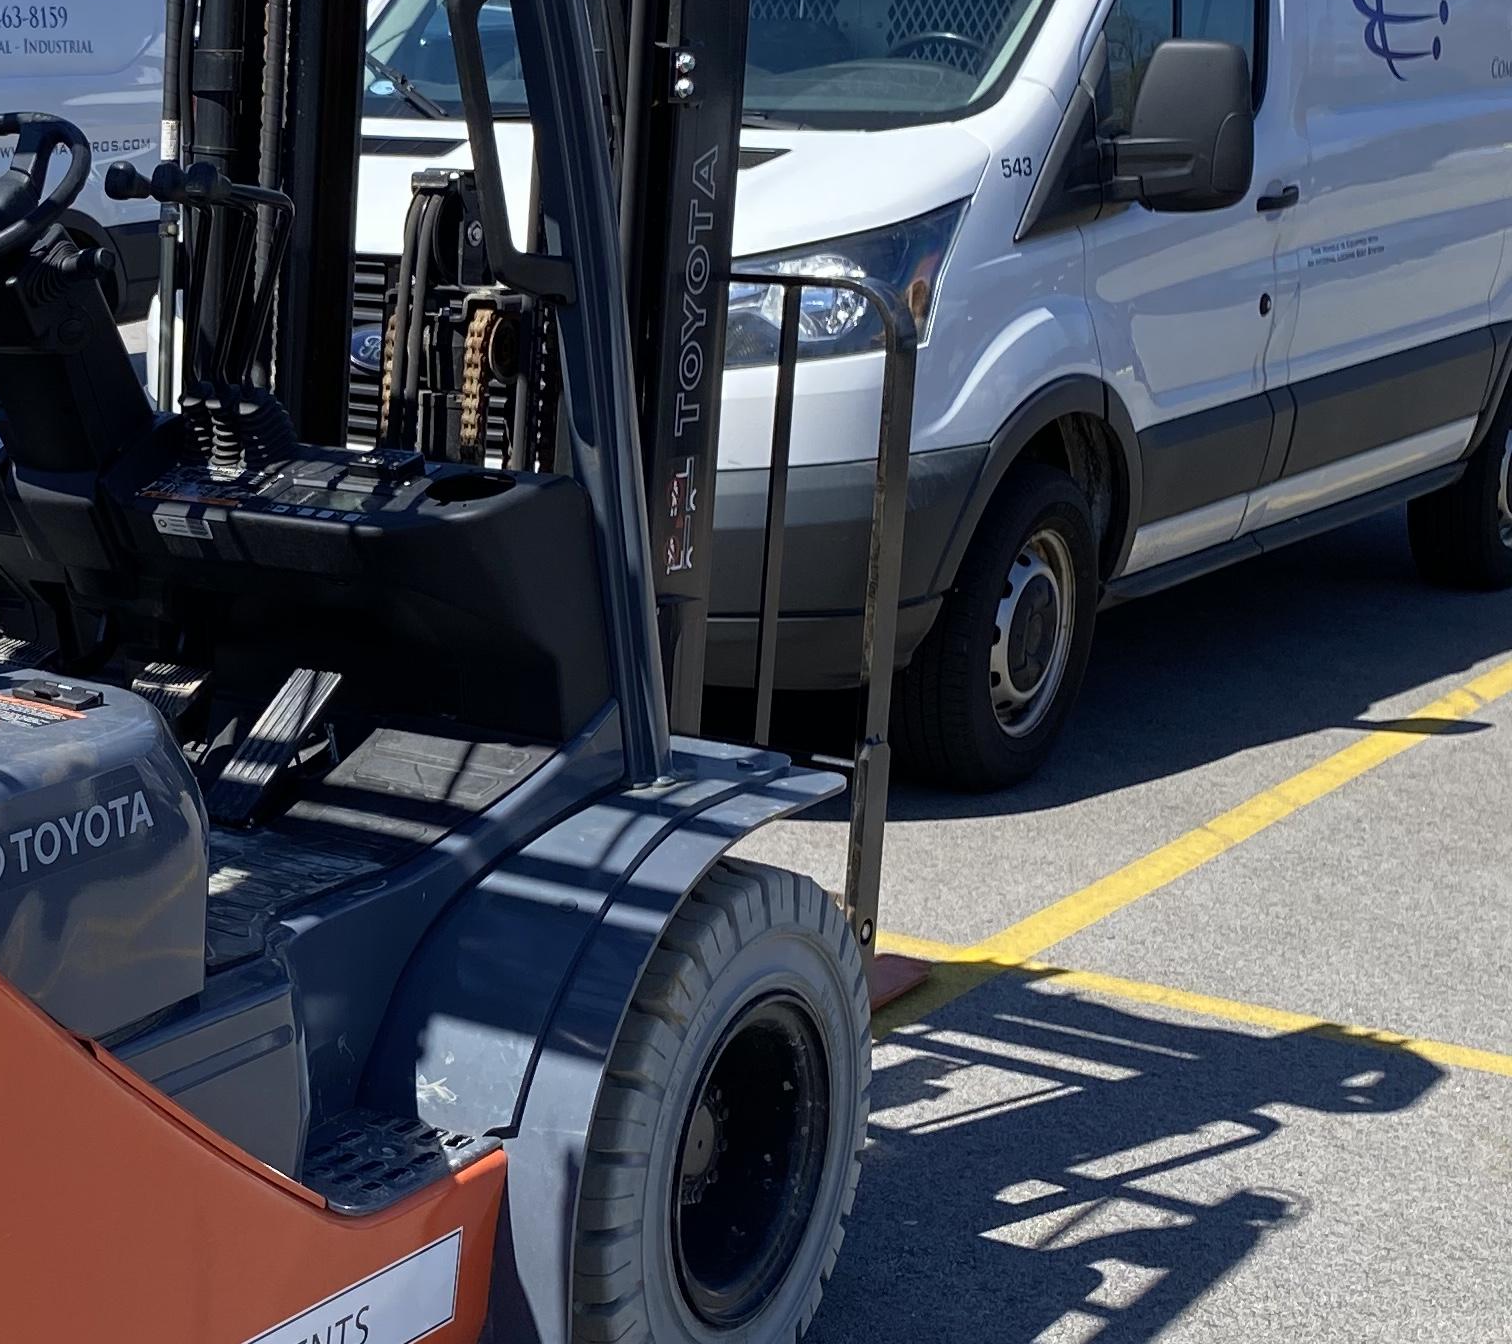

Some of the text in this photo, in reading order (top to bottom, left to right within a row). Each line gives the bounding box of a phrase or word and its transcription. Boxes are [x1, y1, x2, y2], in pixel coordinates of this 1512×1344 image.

[24, 38, 94, 55] INDUSTRIAL
[1001, 156, 1033, 178] 543
[675, 144, 719, 437] TOYOTA
[9, 790, 155, 873] TOYOTA
